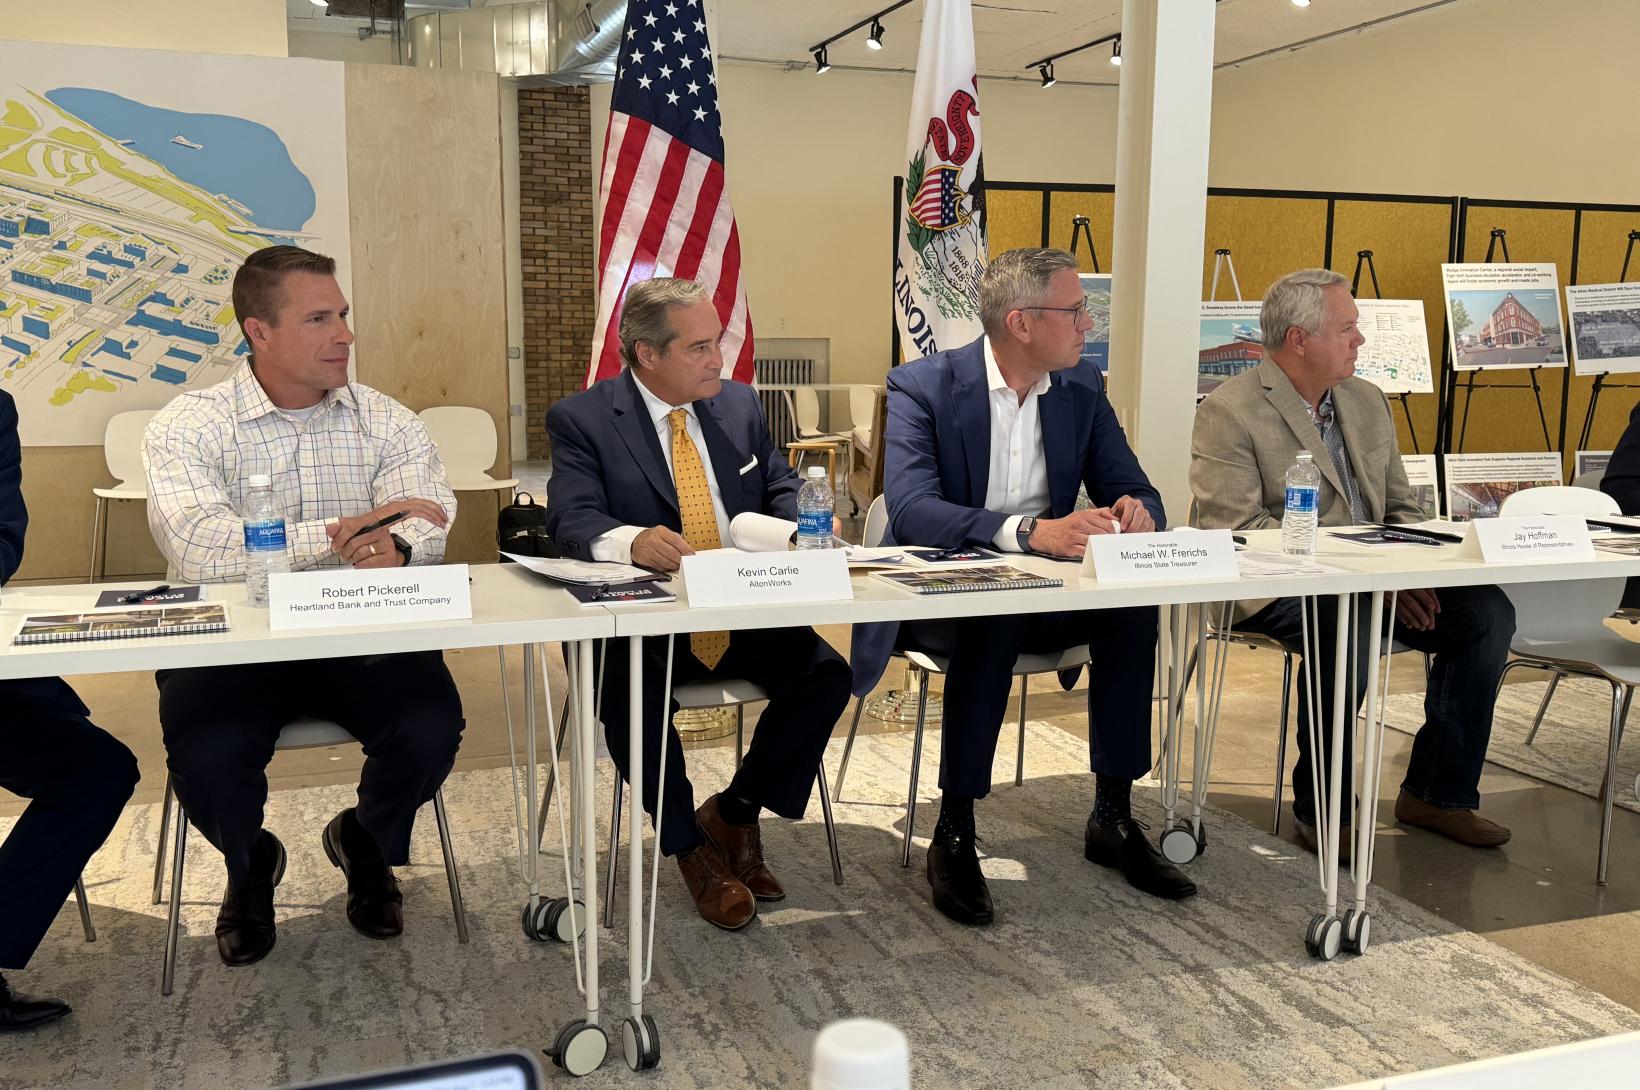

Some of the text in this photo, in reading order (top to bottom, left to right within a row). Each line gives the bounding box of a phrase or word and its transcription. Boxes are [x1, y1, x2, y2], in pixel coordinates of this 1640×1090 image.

[951, 246, 970, 269] 1868
[259, 527, 284, 536] AQUAFINA
[1513, 532, 1558, 542] Jay Hoffman
[1120, 548, 1208, 560] Michael W. Frerichs
[737, 566, 799, 578] Kevin Carlie
[749, 580, 792, 588] AltonWorks
[321, 584, 420, 598] Robert Pickerell
[290, 596, 451, 612] Heartland Bank and Trust Company
